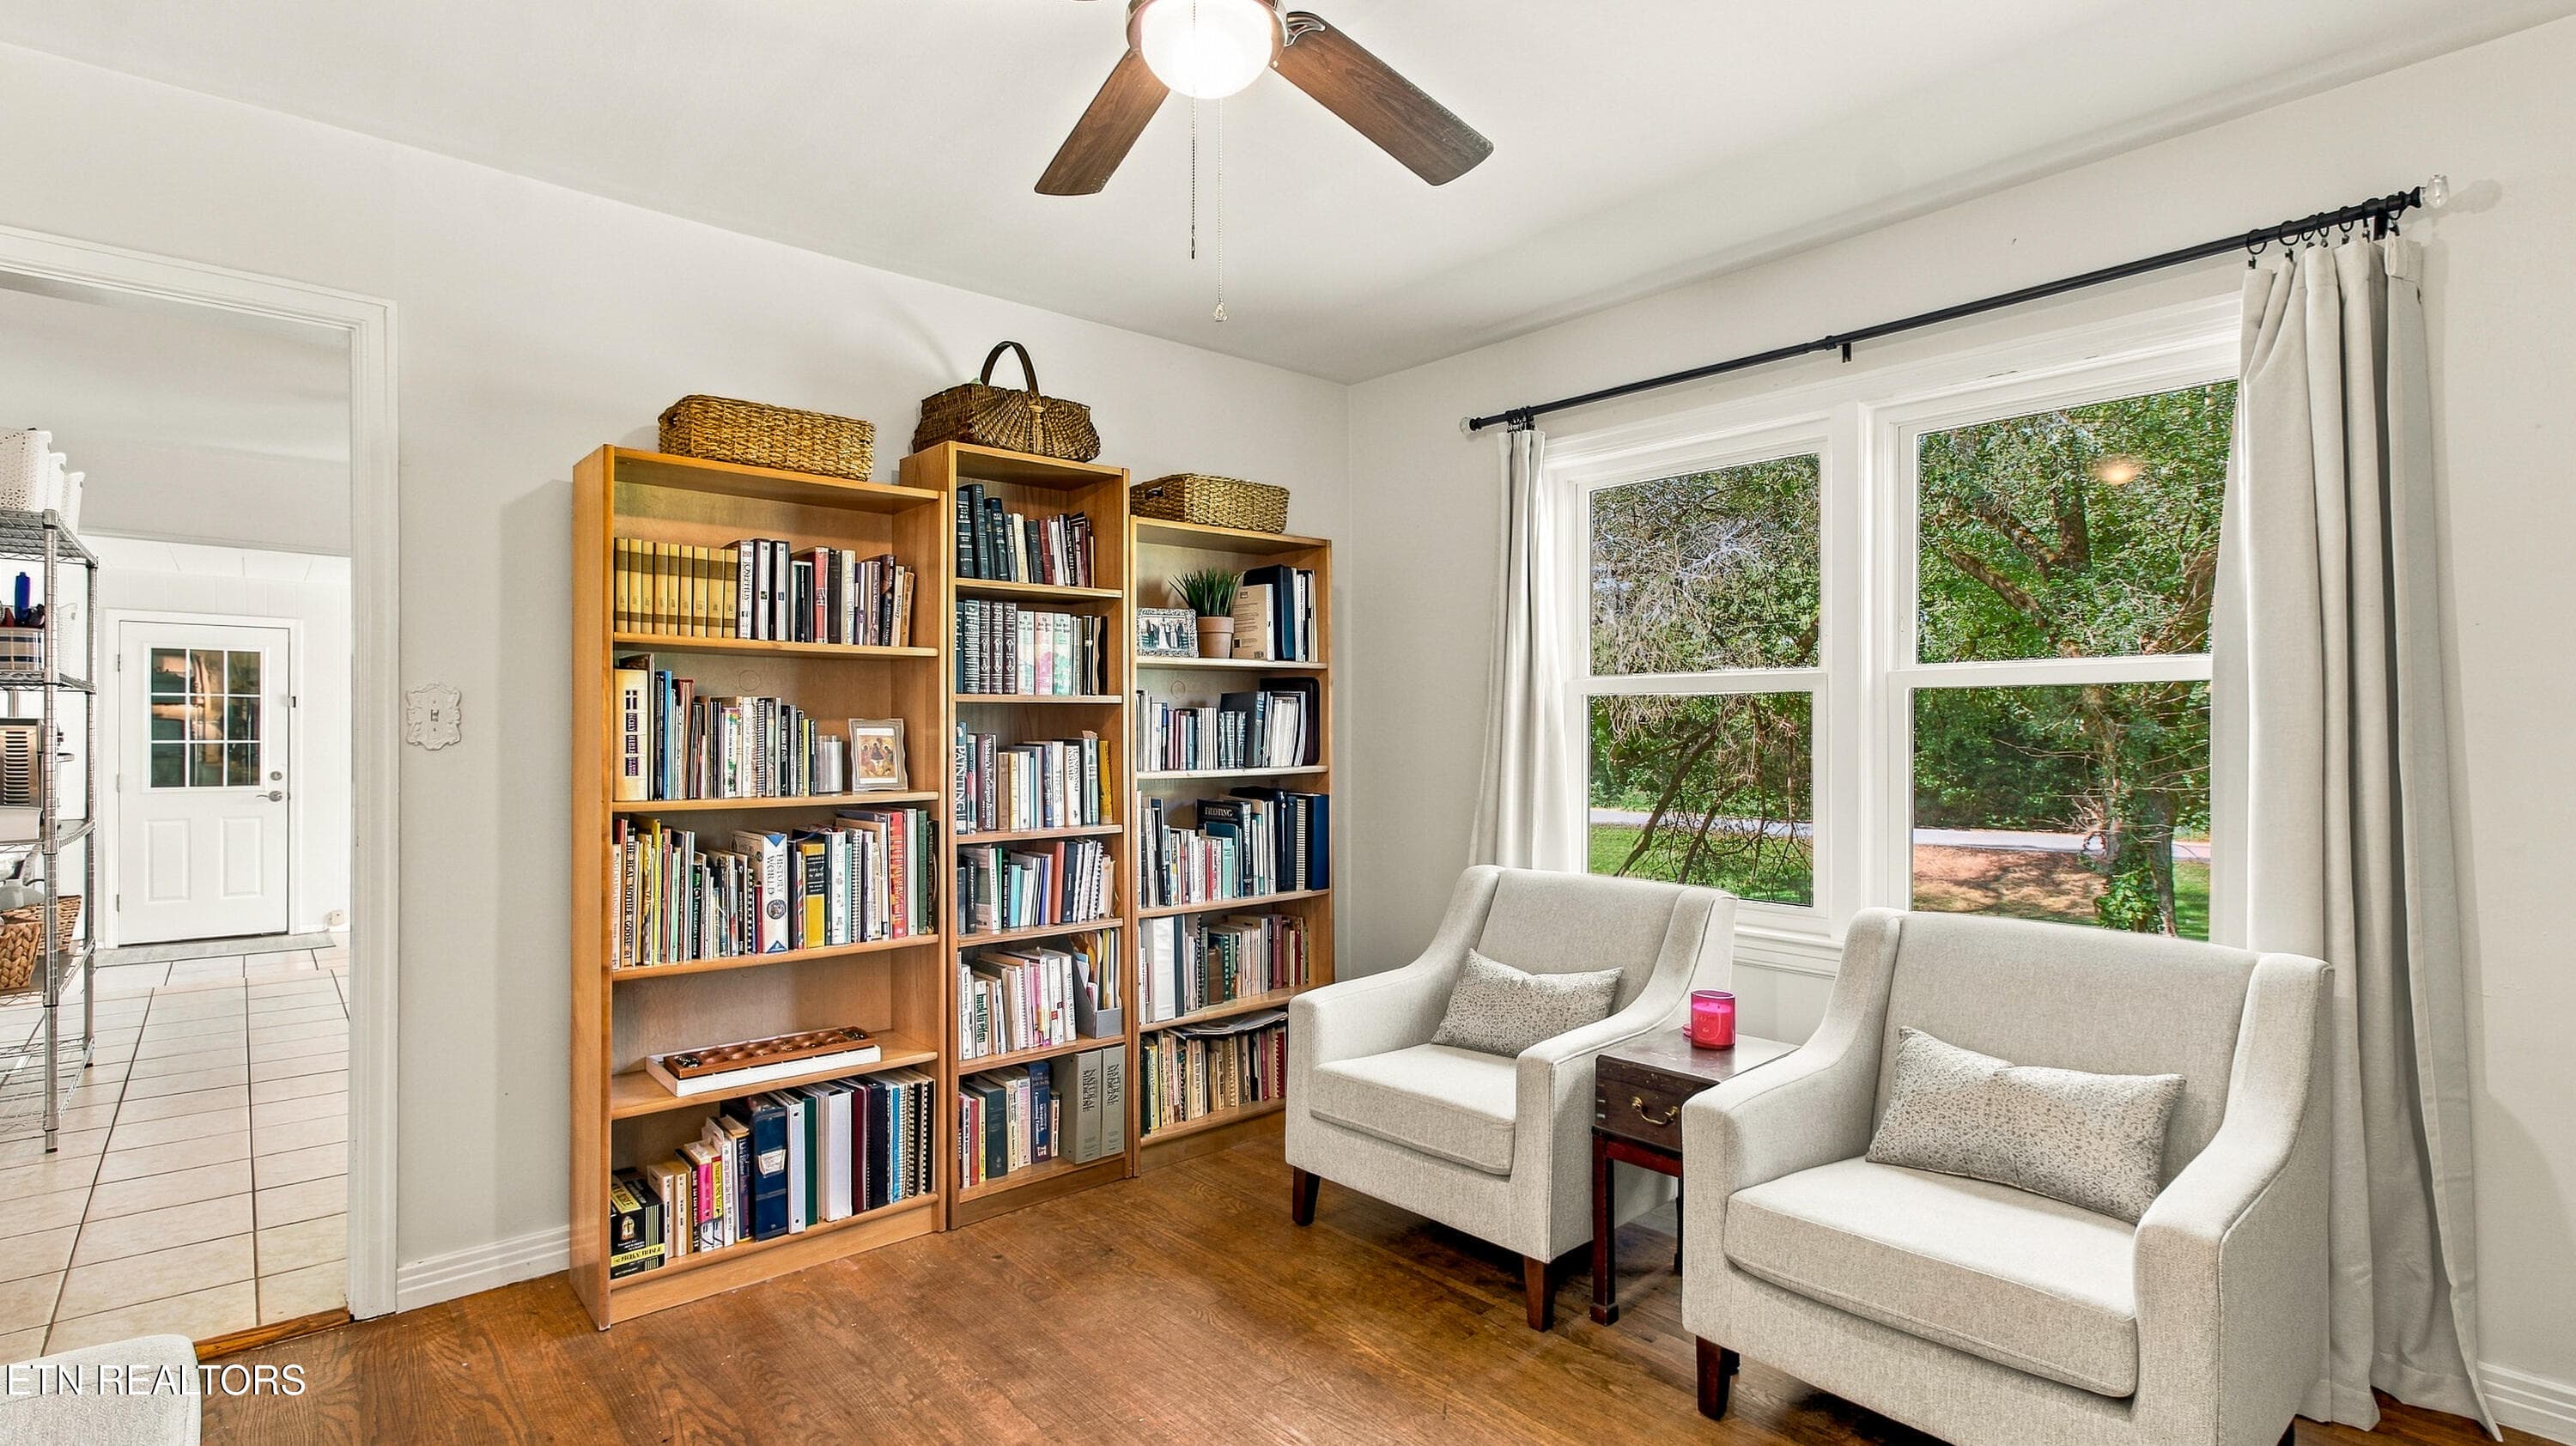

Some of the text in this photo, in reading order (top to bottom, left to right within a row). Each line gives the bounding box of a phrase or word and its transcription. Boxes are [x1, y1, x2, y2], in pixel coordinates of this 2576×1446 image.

[744, 562, 752, 601] JOSEPHUS
[628, 714, 636, 732] HOLY
[628, 736, 636, 754] BIBLE
[956, 745, 966, 811] PAINTING
[1205, 807, 1232, 817] PILOTING
[767, 854, 775, 895] WORLD
[625, 884, 634, 915] MOTHER
[976, 993, 987, 1013] back
[977, 1023, 987, 1043] eden
